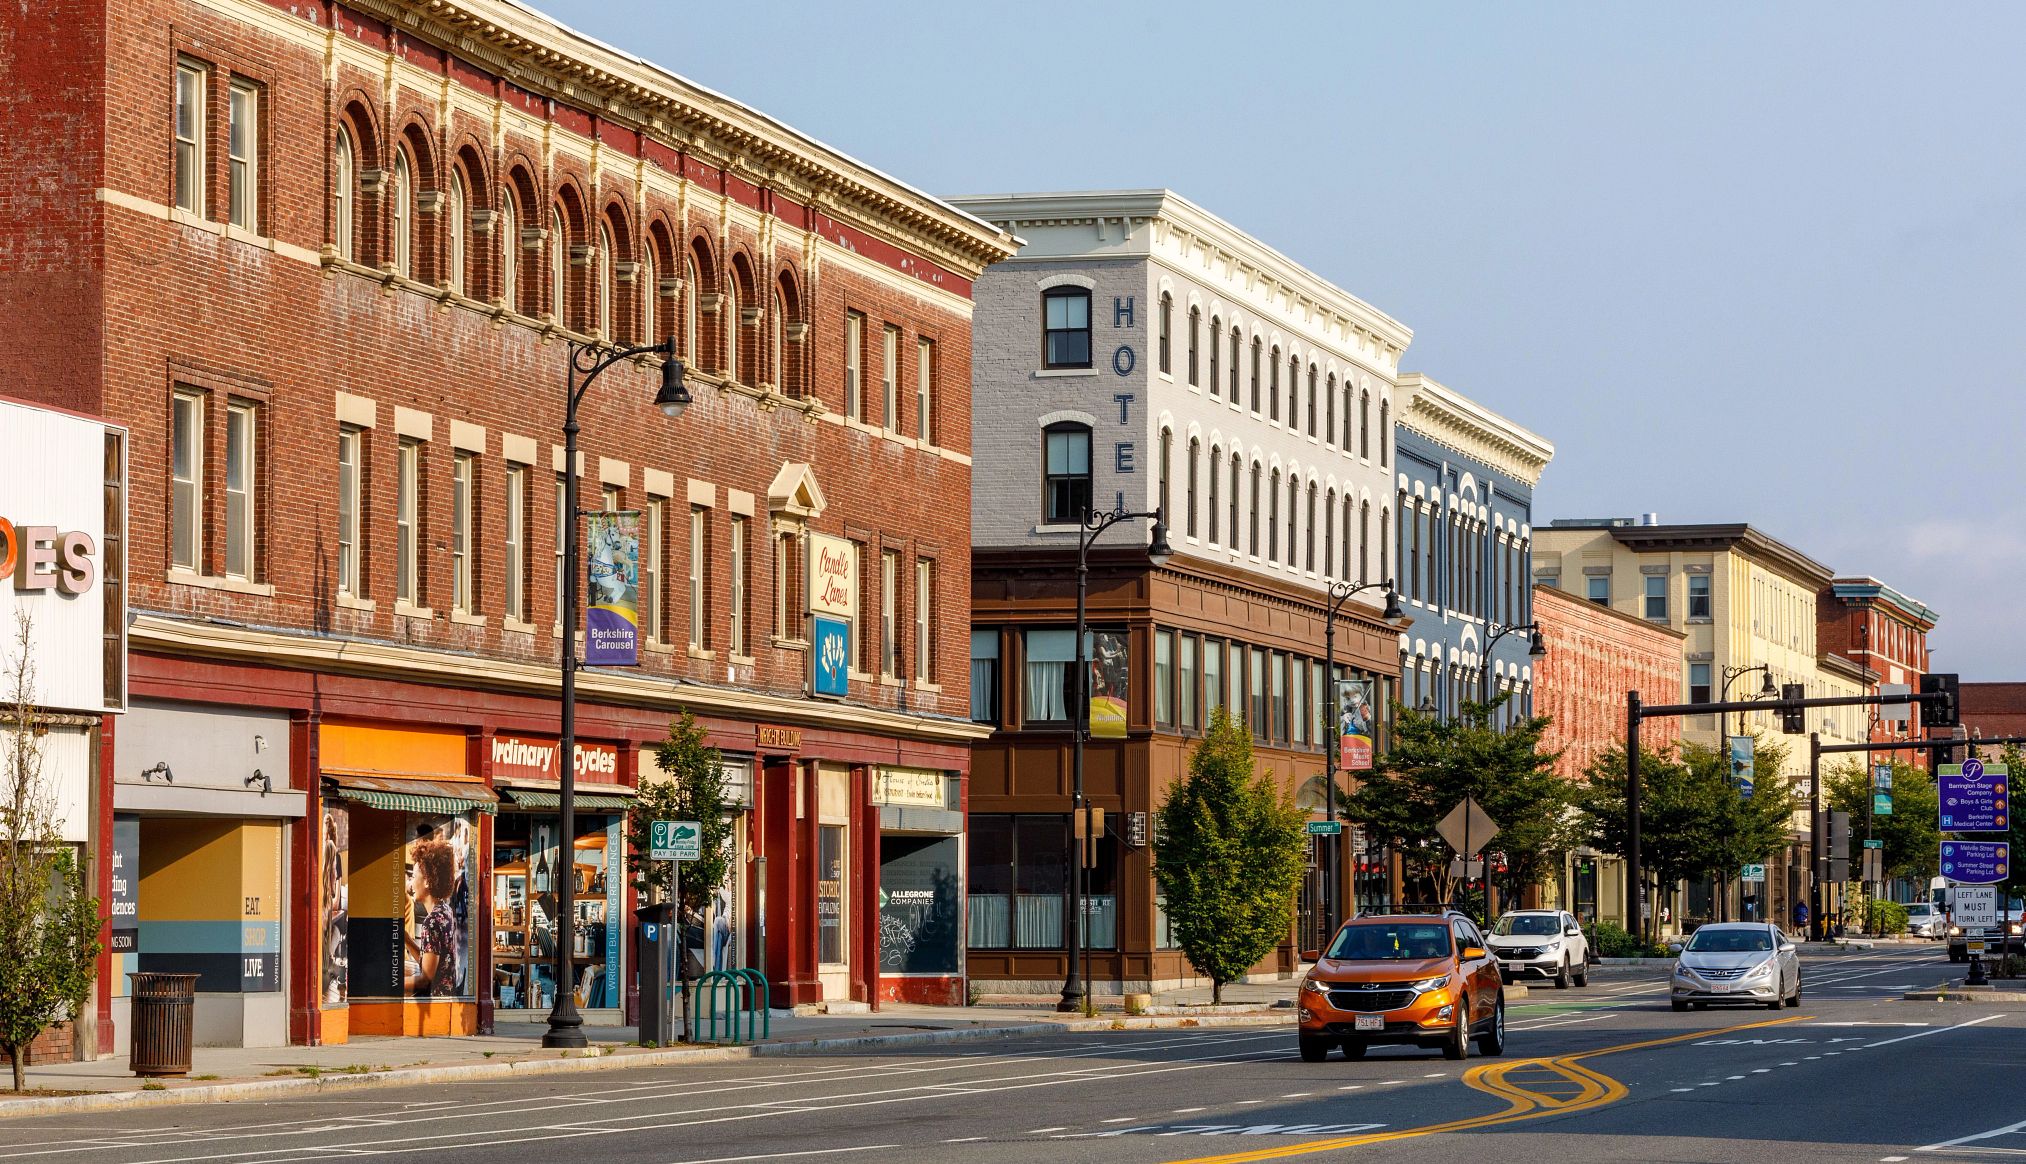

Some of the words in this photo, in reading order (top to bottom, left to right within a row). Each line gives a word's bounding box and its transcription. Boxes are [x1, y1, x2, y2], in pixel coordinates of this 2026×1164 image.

[1113, 296, 1135, 522] HOTEL
[819, 546, 849, 579] Candle
[820, 576, 848, 607] Lanes
[591, 628, 634, 639] Berkshire
[595, 639, 634, 650] Carousel
[1344, 746, 1370, 754] Berkshire
[574, 744, 616, 775] Cycles
[1351, 759, 1370, 767] School
[1310, 823, 1333, 833] Summer
[1966, 851, 1985, 859] Parking
[609, 832, 618, 896] RESIDENCES
[1966, 868, 1985, 876] Parking
[891, 890, 934, 898] ALLEGRONE
[1957, 891, 1973, 899] LEFT
[1975, 891, 1993, 899] LANE
[245, 897, 261, 916] EAT.
[392, 886, 400, 940] BUILDING
[1964, 903, 1987, 911] MUST
[608, 898, 617, 947] BUILDING
[1958, 915, 1975, 923] TURN
[1978, 915, 1993, 923] LEFT
[244, 928, 267, 947] SHOP.
[647, 925, 656, 939] P
[119, 936, 132, 948] SOON
[244, 958, 264, 978] LIVE.
[391, 942, 399, 987] WRIGHT
[608, 949, 616, 991] WRIGHT
[1356, 1018, 1369, 1027] 751
